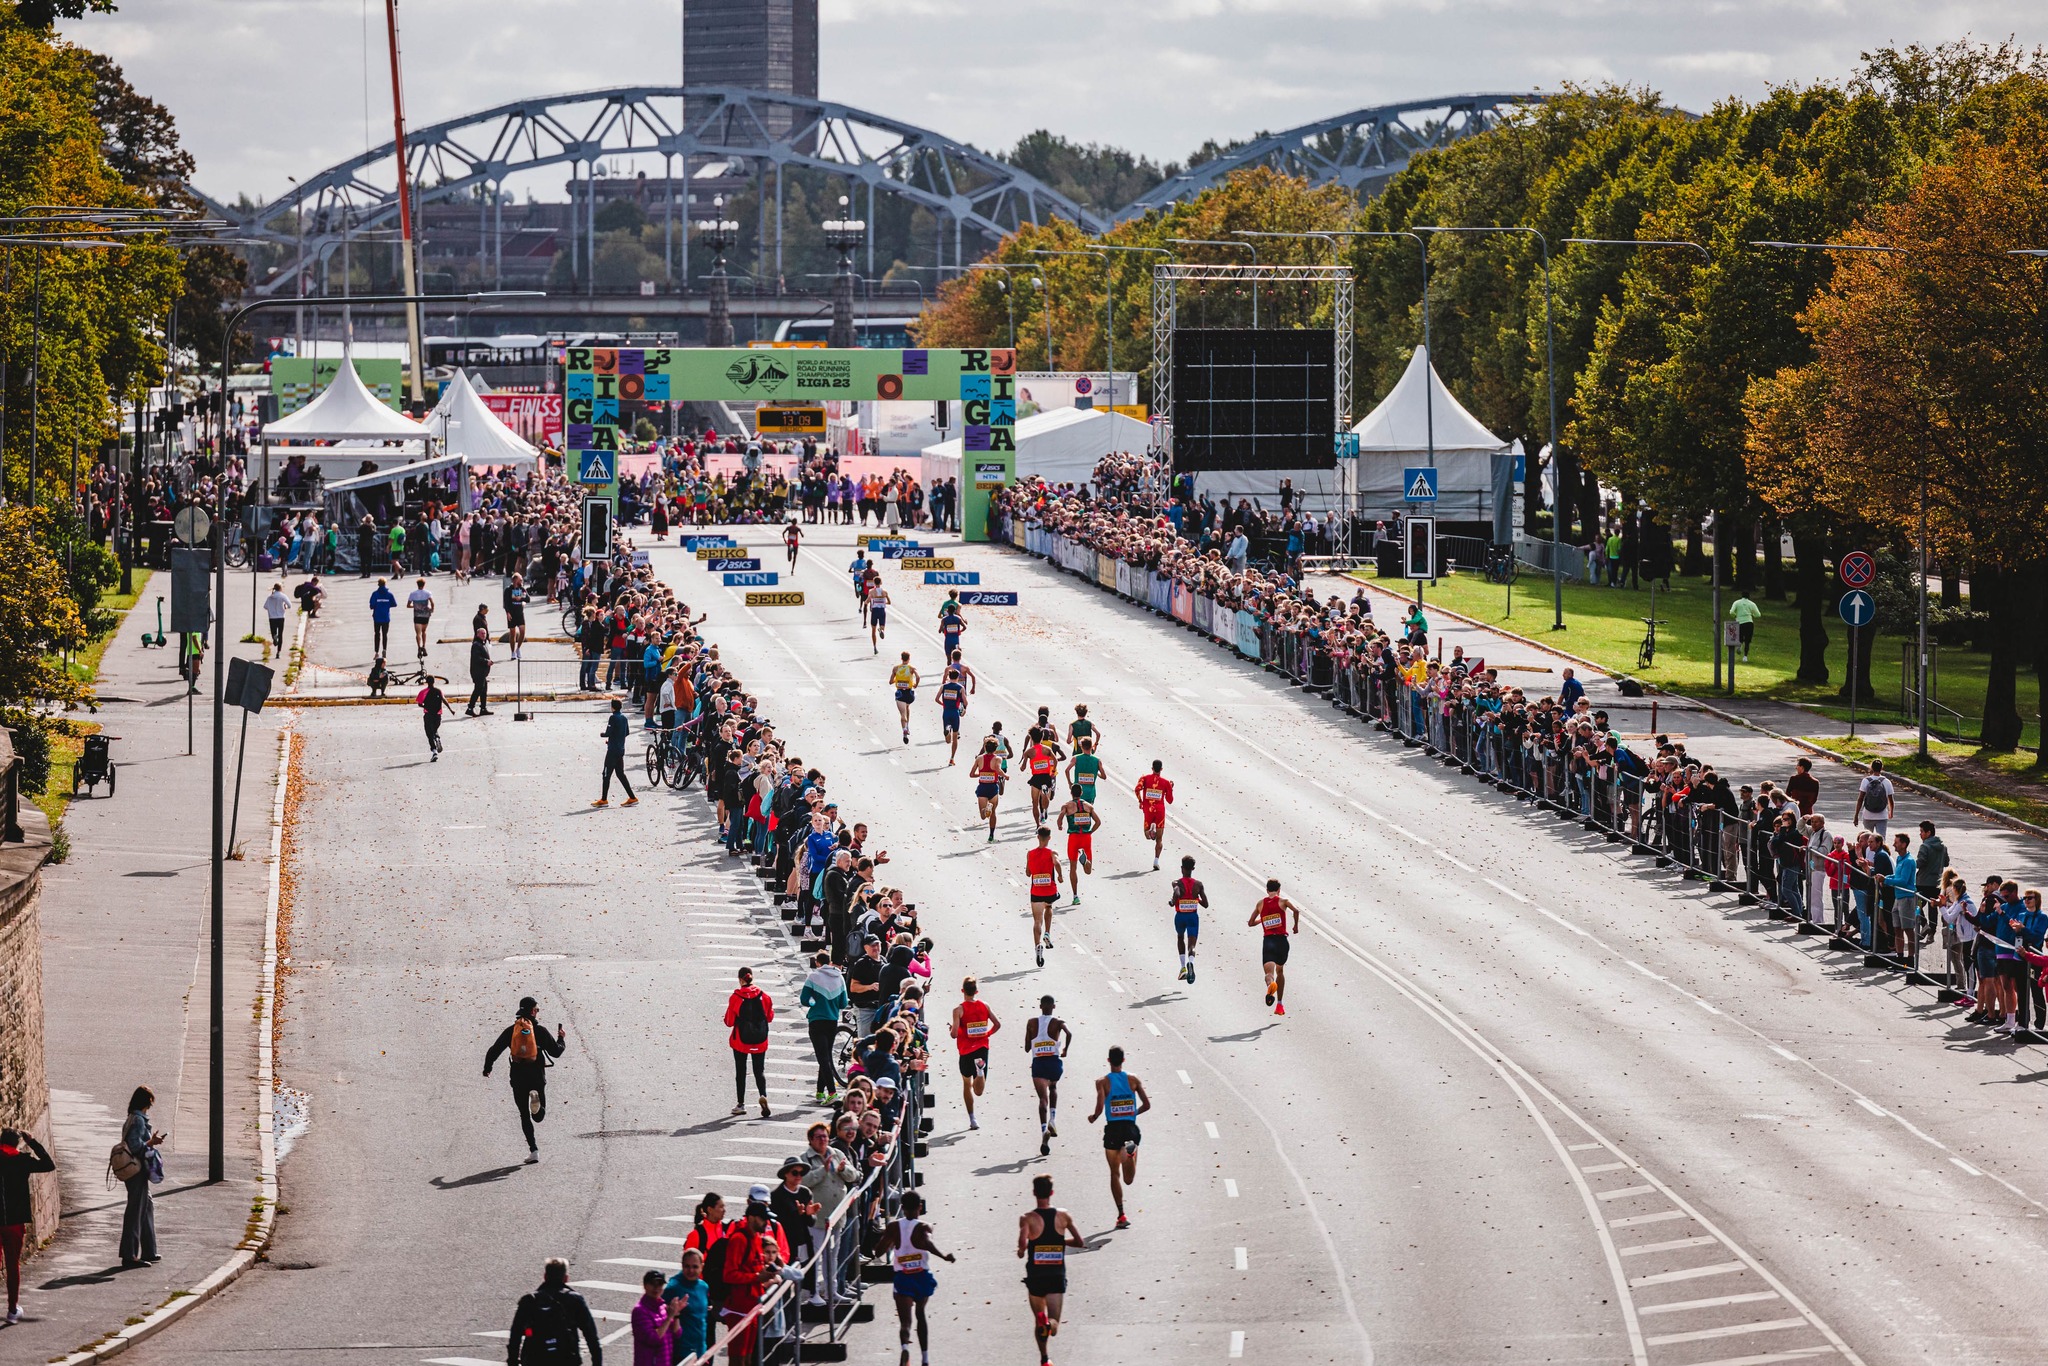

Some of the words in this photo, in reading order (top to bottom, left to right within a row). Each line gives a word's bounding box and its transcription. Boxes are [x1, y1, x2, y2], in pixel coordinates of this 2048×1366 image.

[797, 379, 830, 387] RIGA
[833, 379, 850, 387] 23
[697, 549, 747, 558] SEIKO
[903, 549, 927, 557] asics
[728, 560, 752, 569] asics
[904, 559, 954, 568] SEIKO
[734, 574, 767, 584] NTN
[936, 573, 970, 583] NTN
[746, 593, 803, 604] SEIKO
[982, 594, 1009, 603] asics
